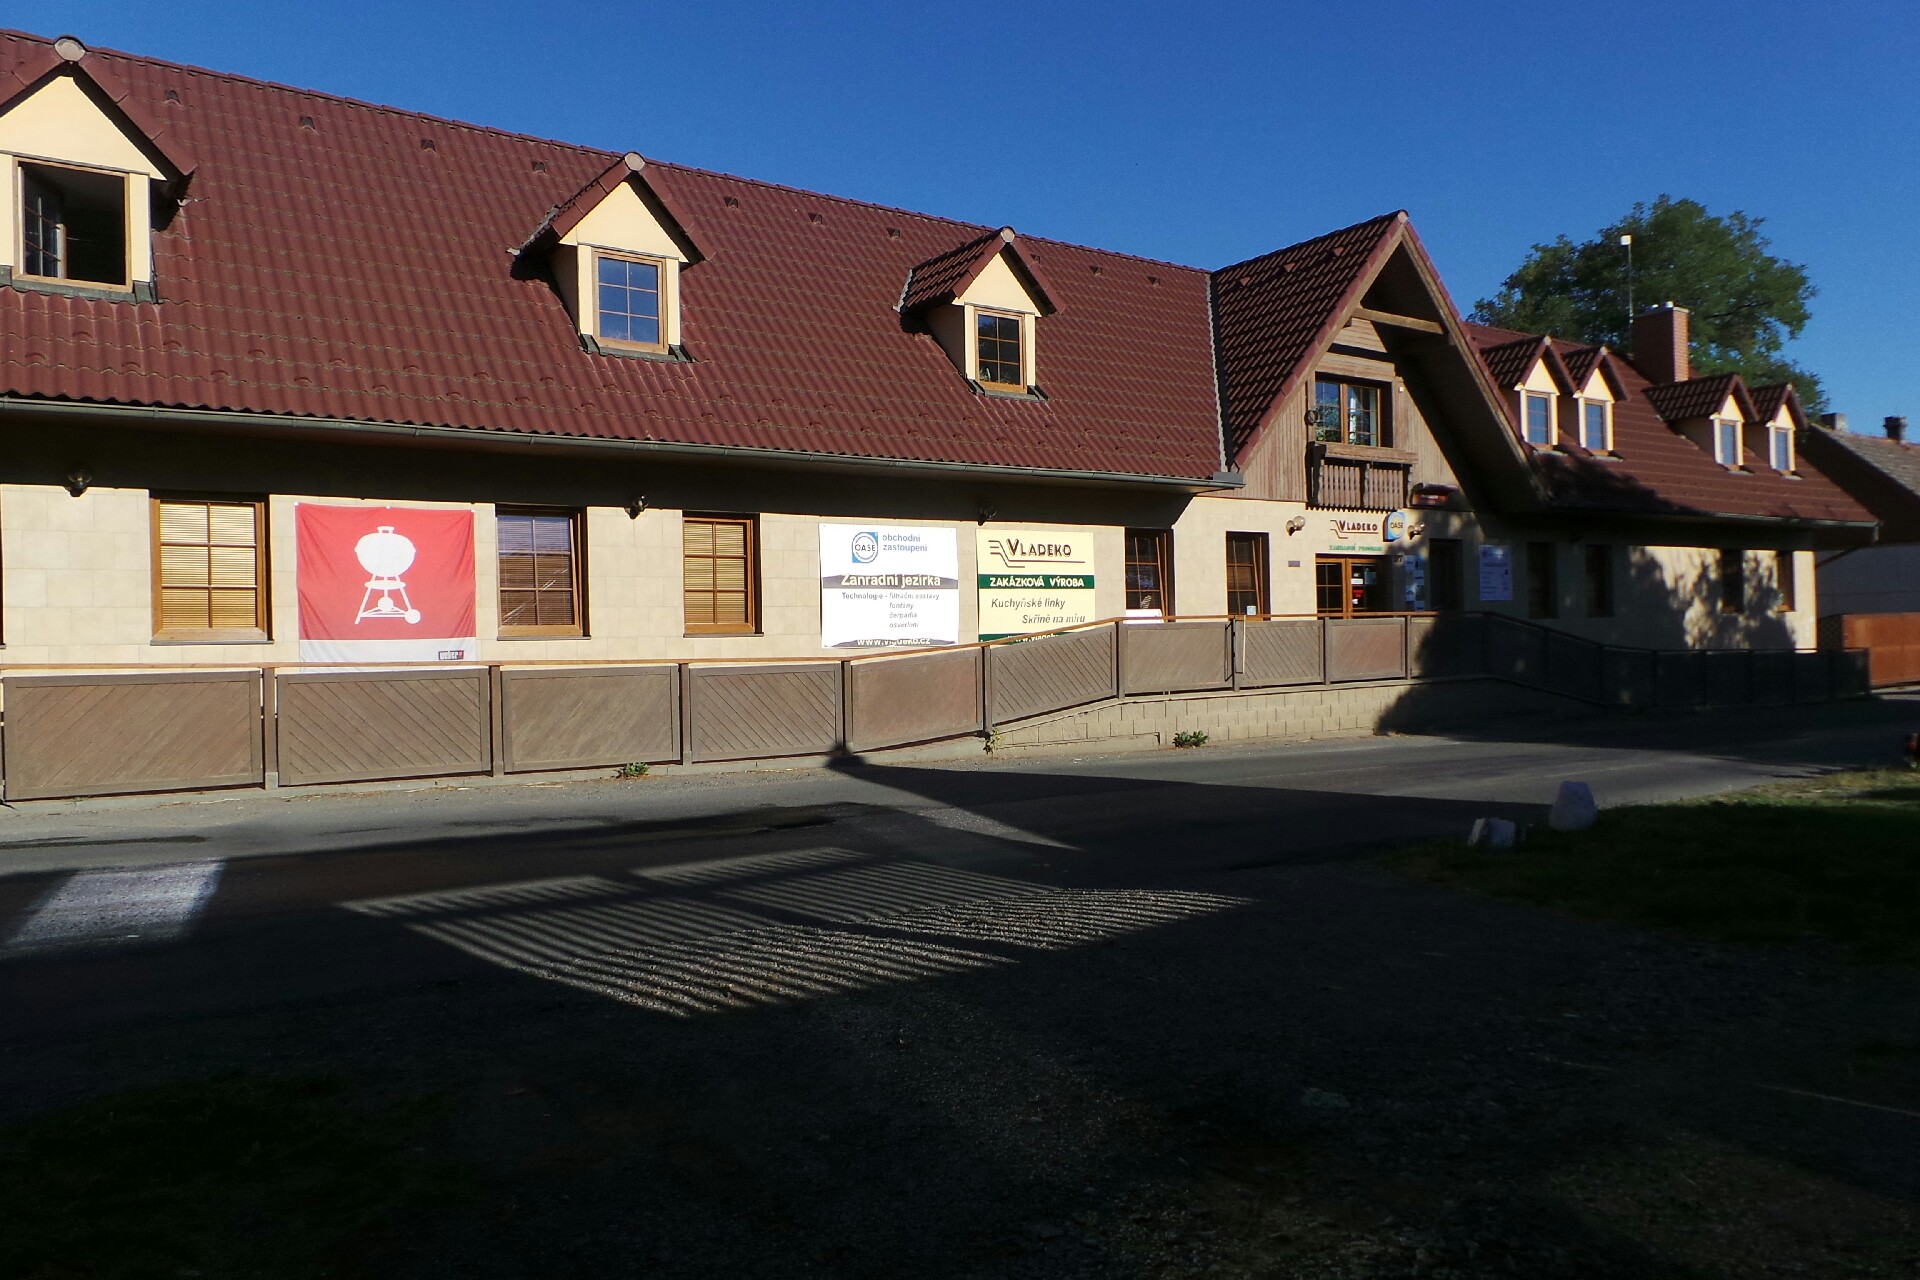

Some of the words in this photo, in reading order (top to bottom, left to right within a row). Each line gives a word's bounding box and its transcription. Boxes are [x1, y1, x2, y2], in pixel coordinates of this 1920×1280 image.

[1338, 520, 1378, 532] VLADEKO
[1390, 521, 1404, 529] OASE
[854, 543, 877, 552] OASE
[1006, 538, 1072, 557] VLADEKO
[901, 574, 941, 589] jezírka
[989, 575, 1045, 587] ZAKÁZKOVÁ
[1049, 576, 1085, 588] VÝROBA
[841, 592, 884, 601] Technologie
[991, 597, 1043, 610] Kuchyňské
[1045, 598, 1066, 610] linky
[1022, 613, 1051, 624] Skříně
[1065, 613, 1086, 623] míru
